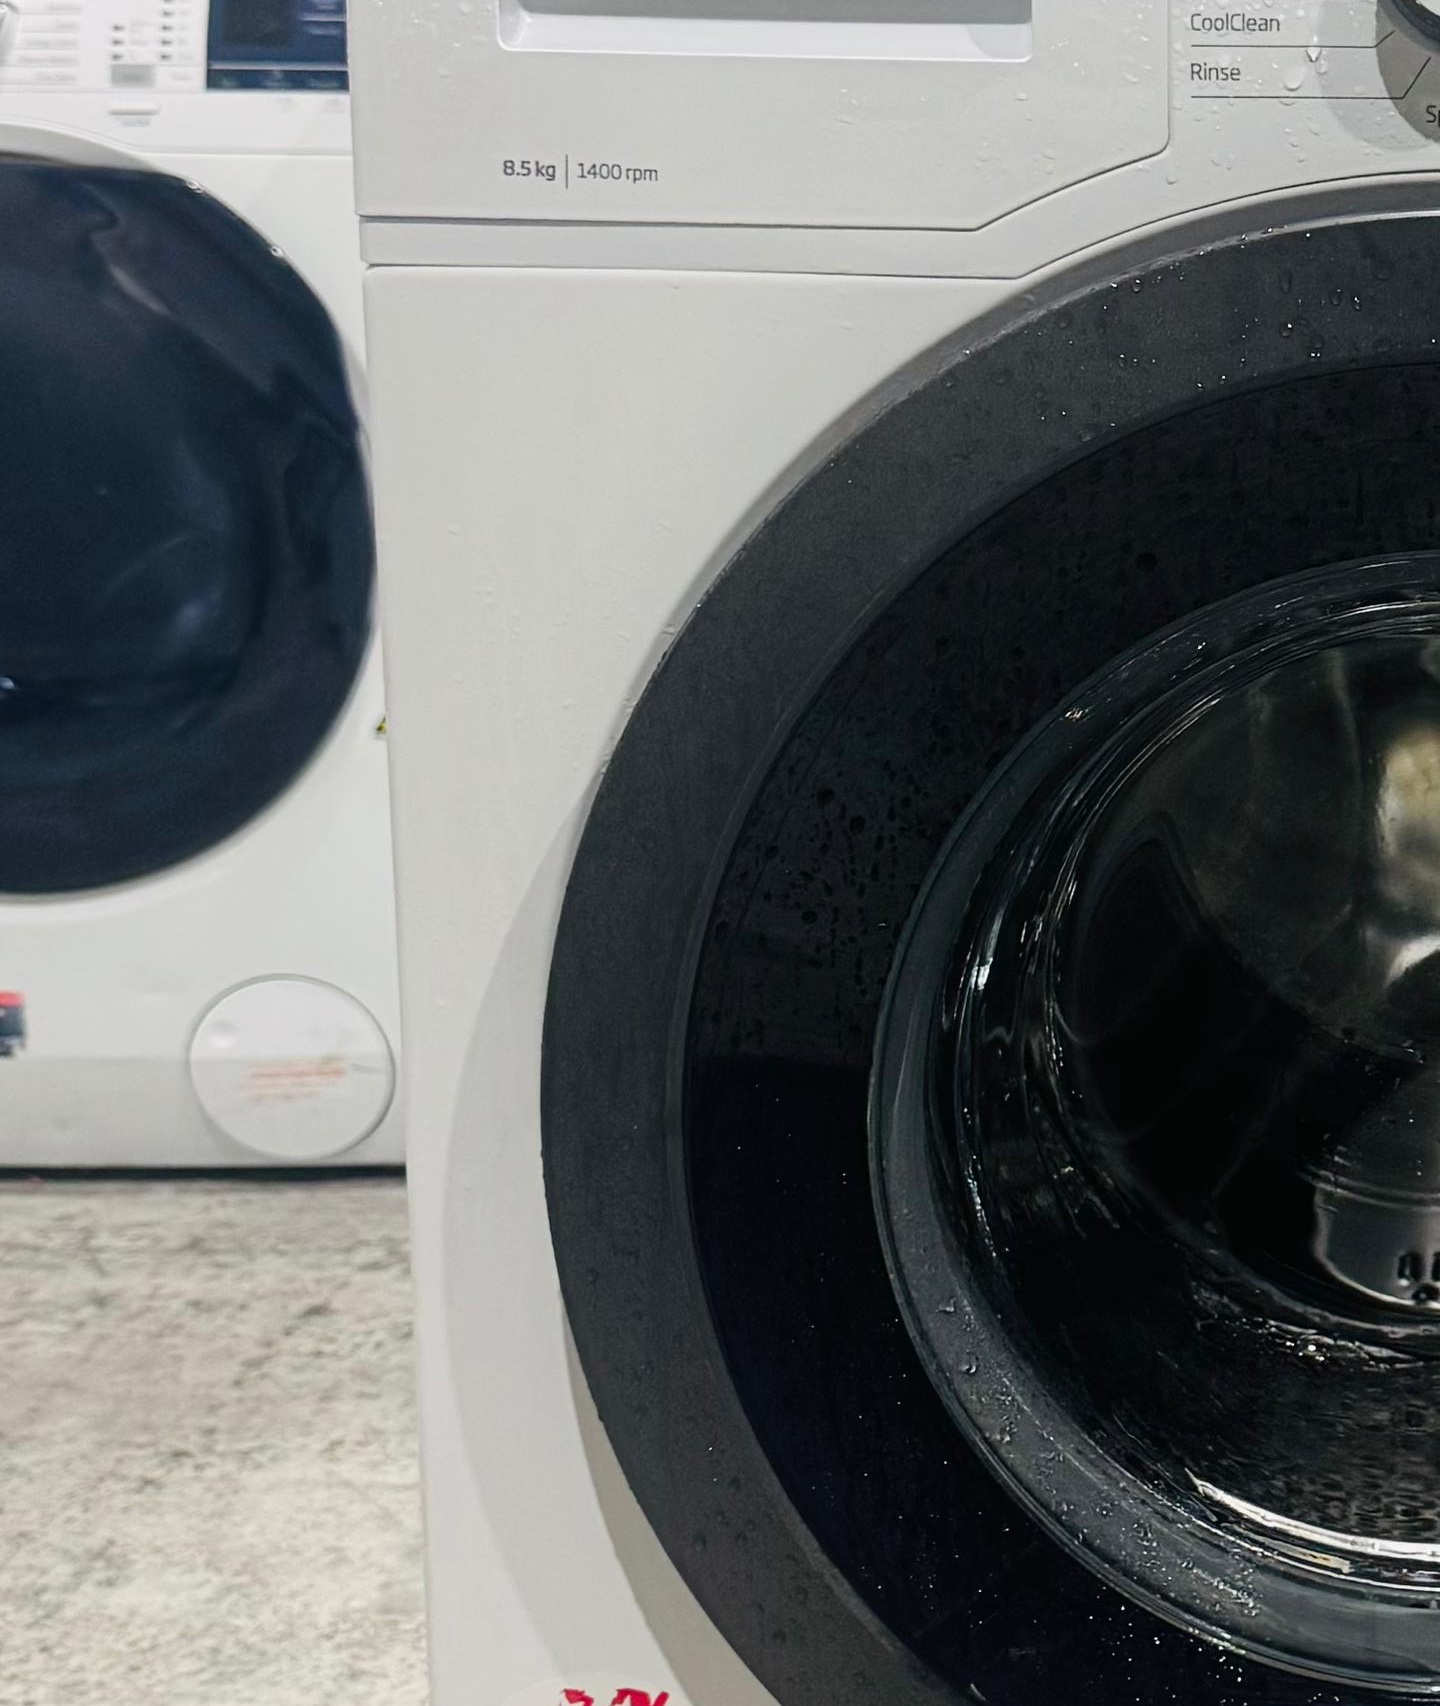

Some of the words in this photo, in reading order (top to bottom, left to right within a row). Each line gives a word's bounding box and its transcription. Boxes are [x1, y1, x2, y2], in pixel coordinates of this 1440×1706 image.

[1190, 13, 1281, 32] CoolClean
[1190, 62, 1242, 81] Rinse
[503, 160, 531, 177] 8.5
[535, 161, 556, 181] kg
[577, 163, 622, 180] 1400
[626, 167, 659, 184] rpm
